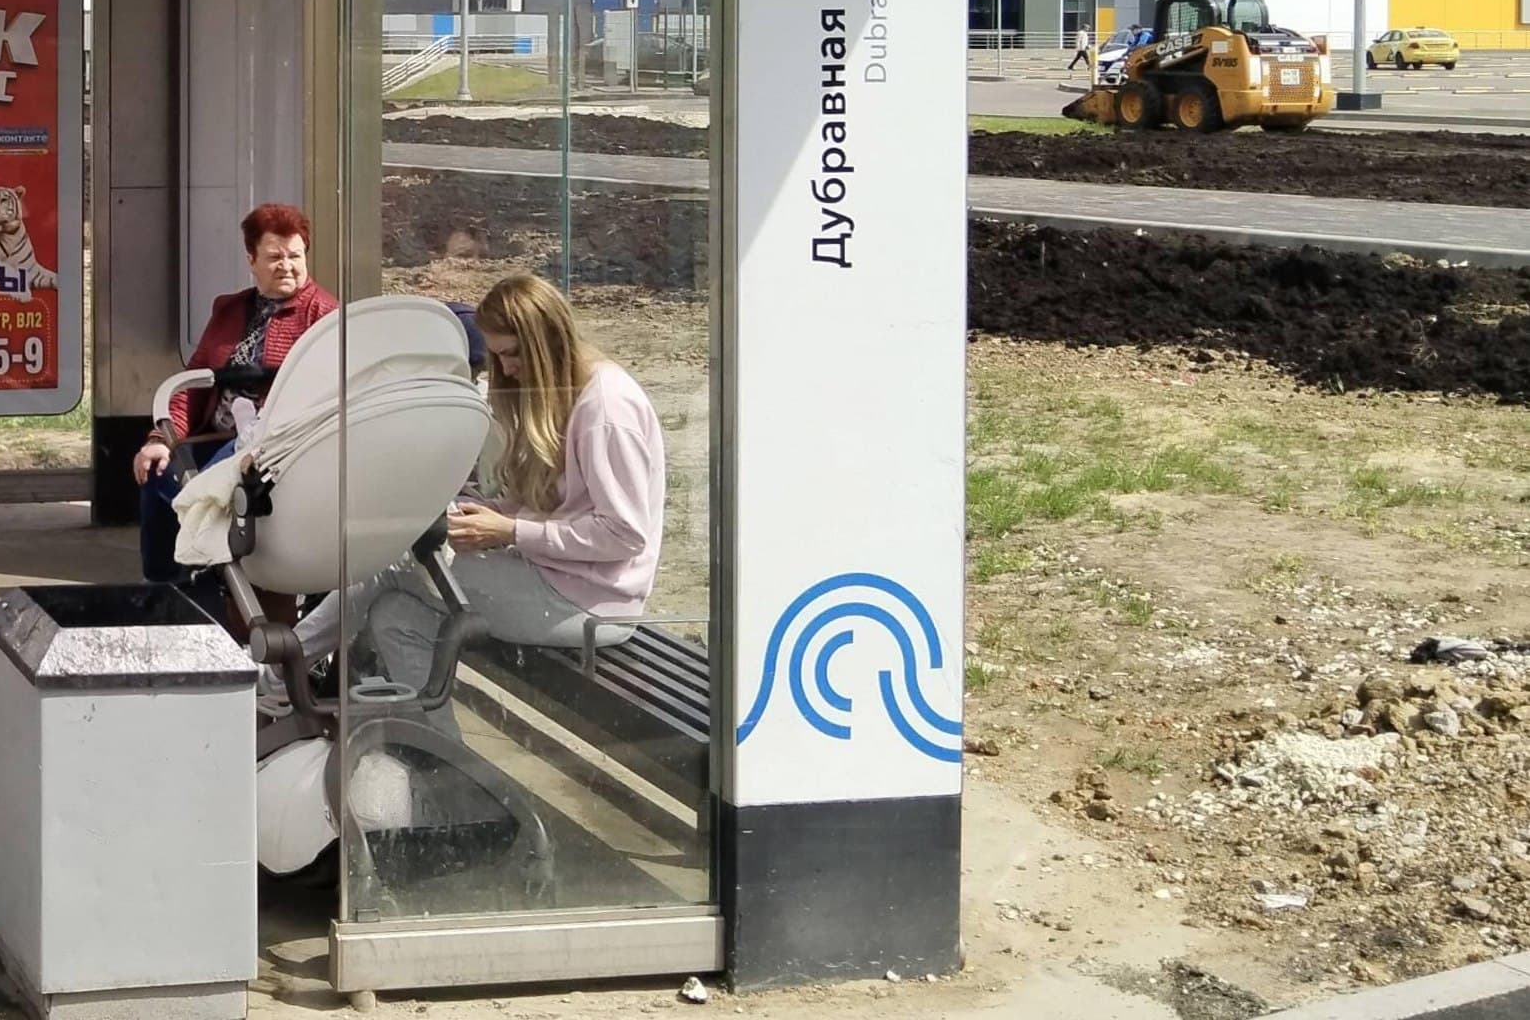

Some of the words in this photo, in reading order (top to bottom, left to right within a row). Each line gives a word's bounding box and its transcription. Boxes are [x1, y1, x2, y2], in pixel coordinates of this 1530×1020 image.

[1156, 37, 1192, 55] CASE
[811, 8, 854, 269] Дубравная
[16, 312, 42, 328] ВЛ2
